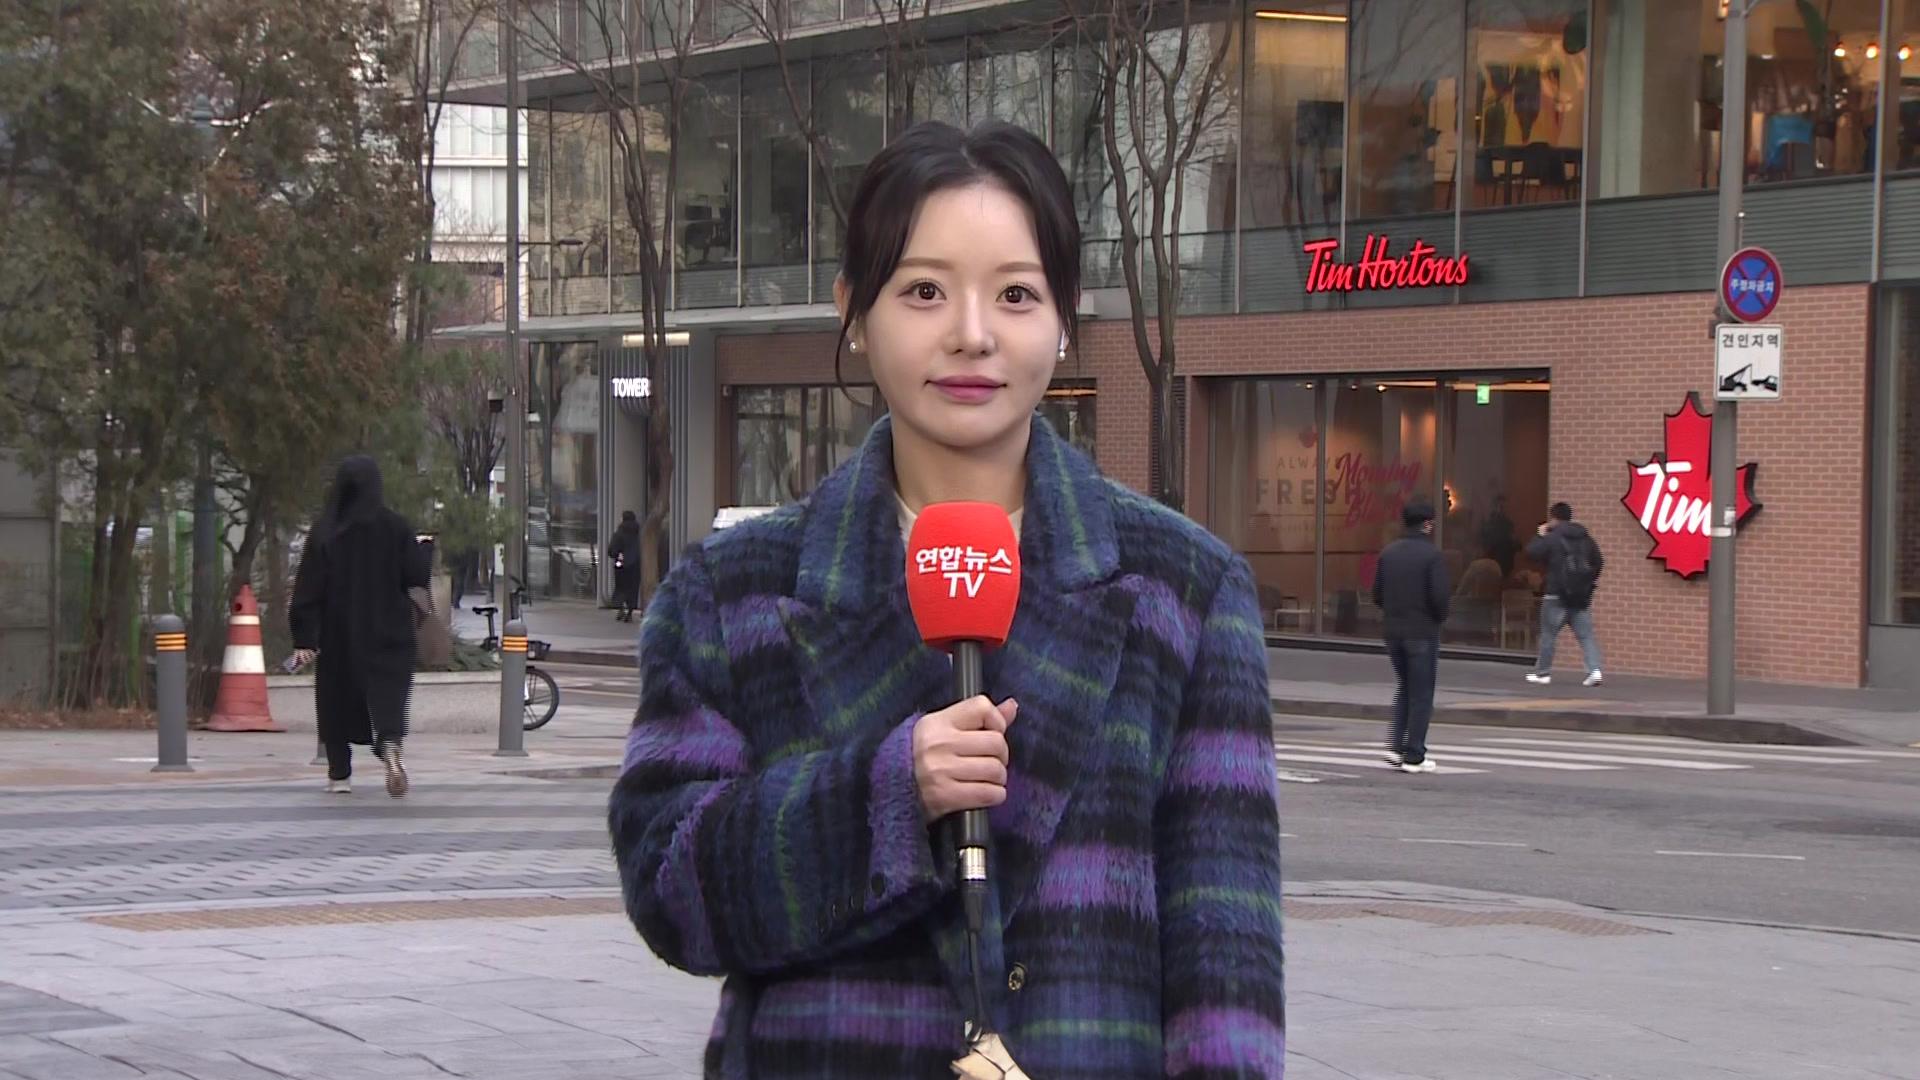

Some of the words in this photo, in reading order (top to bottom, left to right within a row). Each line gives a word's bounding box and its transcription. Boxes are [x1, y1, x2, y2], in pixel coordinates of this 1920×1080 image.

[1304, 238, 1353, 293] Tim
[1357, 233, 1469, 290] Hortons
[1722, 333, 1778, 348] 견인지역
[612, 377, 650, 397] TOWER
[915, 546, 1012, 575] 연합뉴스
[943, 572, 986, 598] TV
